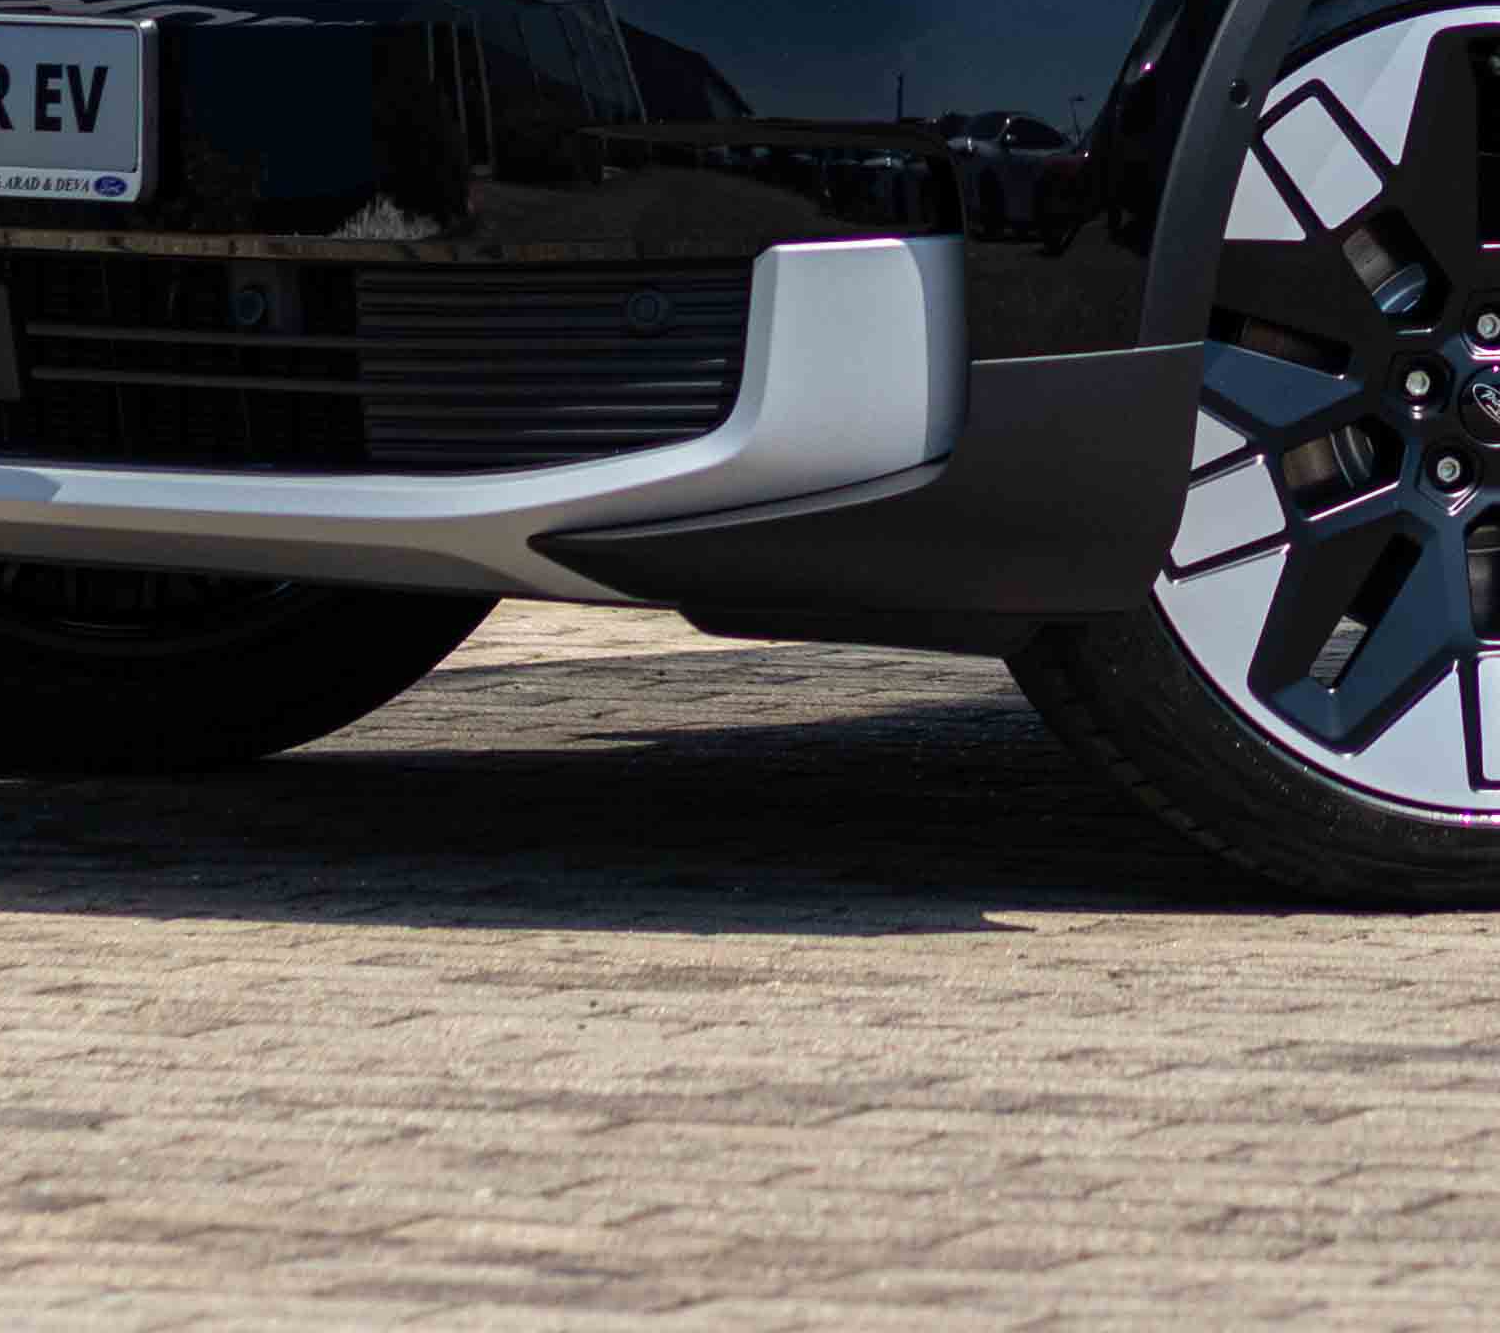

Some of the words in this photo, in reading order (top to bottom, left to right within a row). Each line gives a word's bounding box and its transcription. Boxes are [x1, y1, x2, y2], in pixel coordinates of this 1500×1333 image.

[34, 63, 109, 134] EV
[3, 174, 40, 191] ARAD
[54, 177, 90, 193] DEVA
